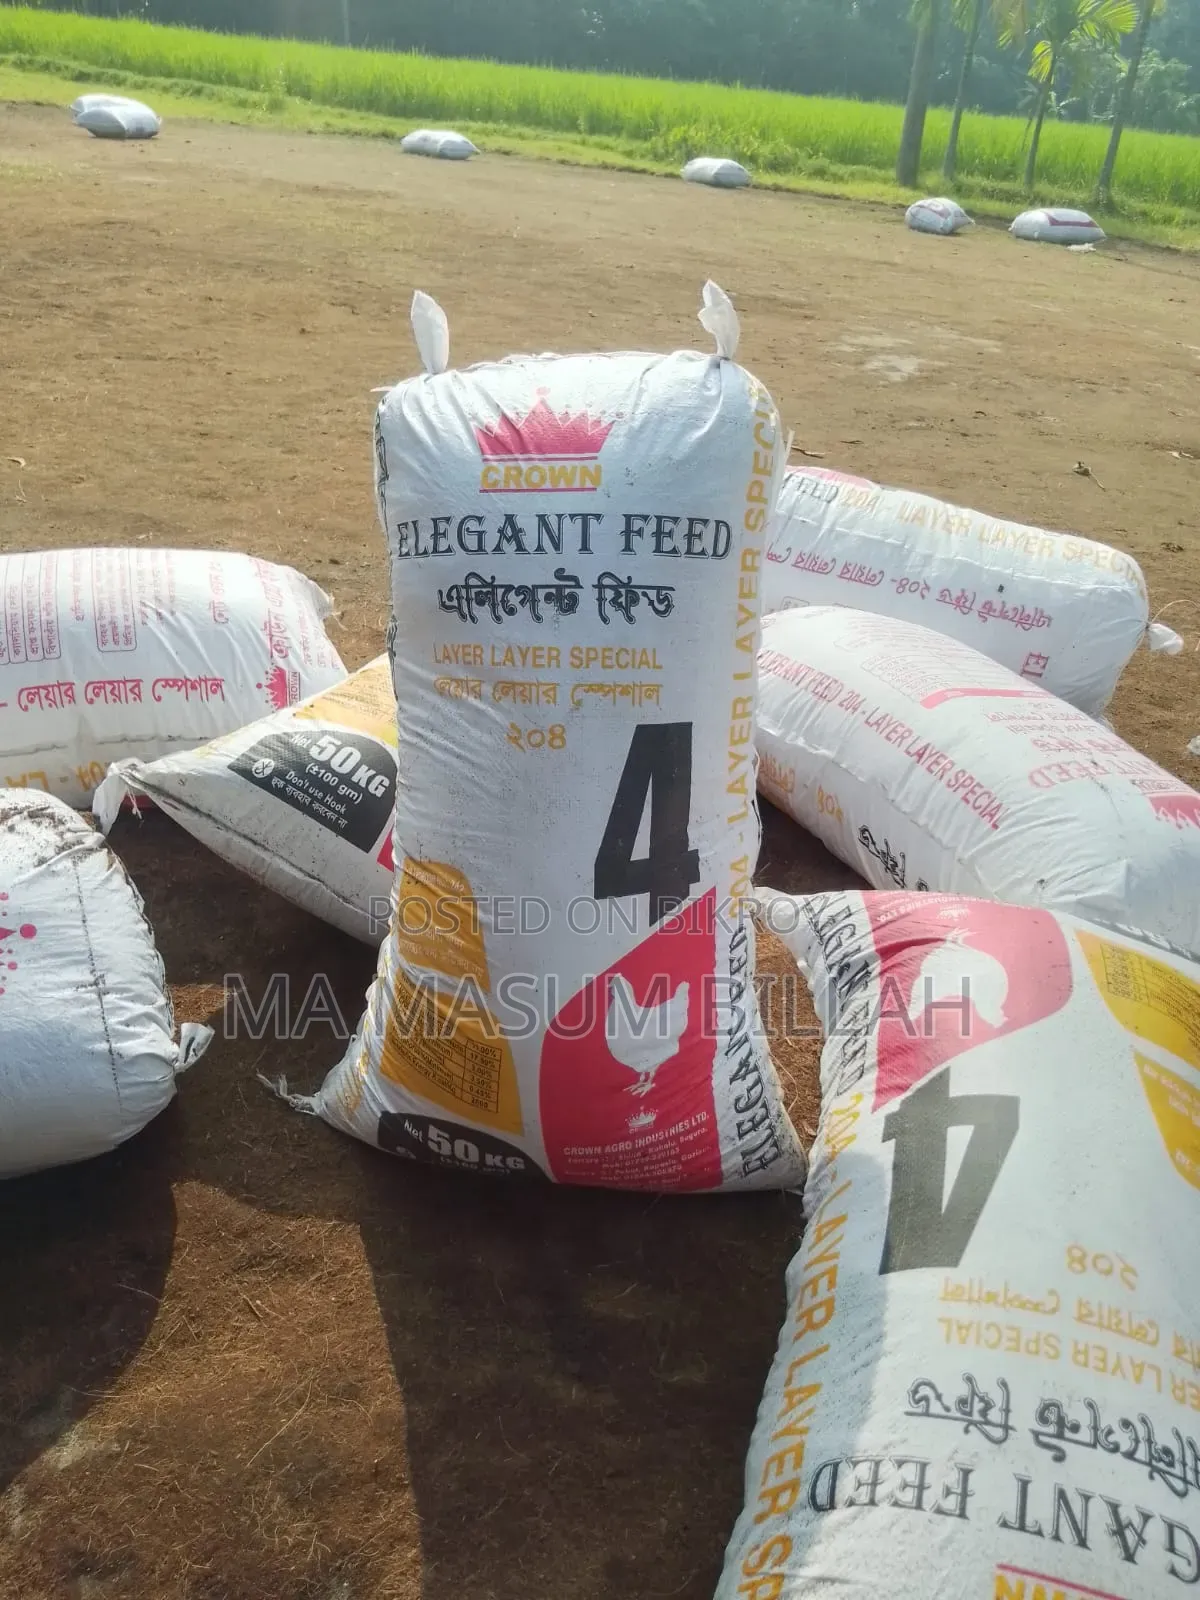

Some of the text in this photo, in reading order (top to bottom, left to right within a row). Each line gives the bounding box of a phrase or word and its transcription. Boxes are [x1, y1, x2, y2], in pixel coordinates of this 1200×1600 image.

[480, 463, 602, 489] CROWN
[396, 512, 733, 561] ELEGANT FEED
[438, 566, 677, 626] এলিগেন্ট ফিড
[732, 546, 762, 682] LAYER
[433, 643, 664, 671] LAYER LAYER SPECIAL
[18, 676, 225, 712] লেয়ার লেয়ার স্পেশাল
[288, 671, 299, 706] ROWN
[491, 679, 560, 708] লেয়ার
[570, 680, 664, 712] স্পেশাল
[506, 722, 568, 753] ২০৪
[725, 694, 752, 826] LAYER
[285, 770, 347, 815] Don't use Hook
[291, 733, 390, 799] Net 50 KG
[305, 762, 363, 805] (±100 gm)
[864, 706, 913, 751] LAYER
[903, 735, 957, 785] LAYER
[945, 770, 1011, 830] SPECIAL
[594, 721, 702, 929] 4
[404, 1119, 526, 1171] Net 50 KG
[605, 1140, 632, 1153] AGRO
[691, 1111, 710, 1126] LTD.
[881, 1065, 1022, 1276] 4
[792, 1180, 853, 1343] LAYER
[1065, 1241, 1140, 1292] ২০৪
[937, 1315, 1062, 1361] SPECIAL
[940, 1276, 1160, 1348] লেয়ার স্পেশাল
[1071, 1338, 1163, 1394] LAYER
[754, 1343, 831, 1527] LAYER
[904, 1371, 1016, 1445] ফিড
[806, 1453, 1200, 1584] GANT FEED
